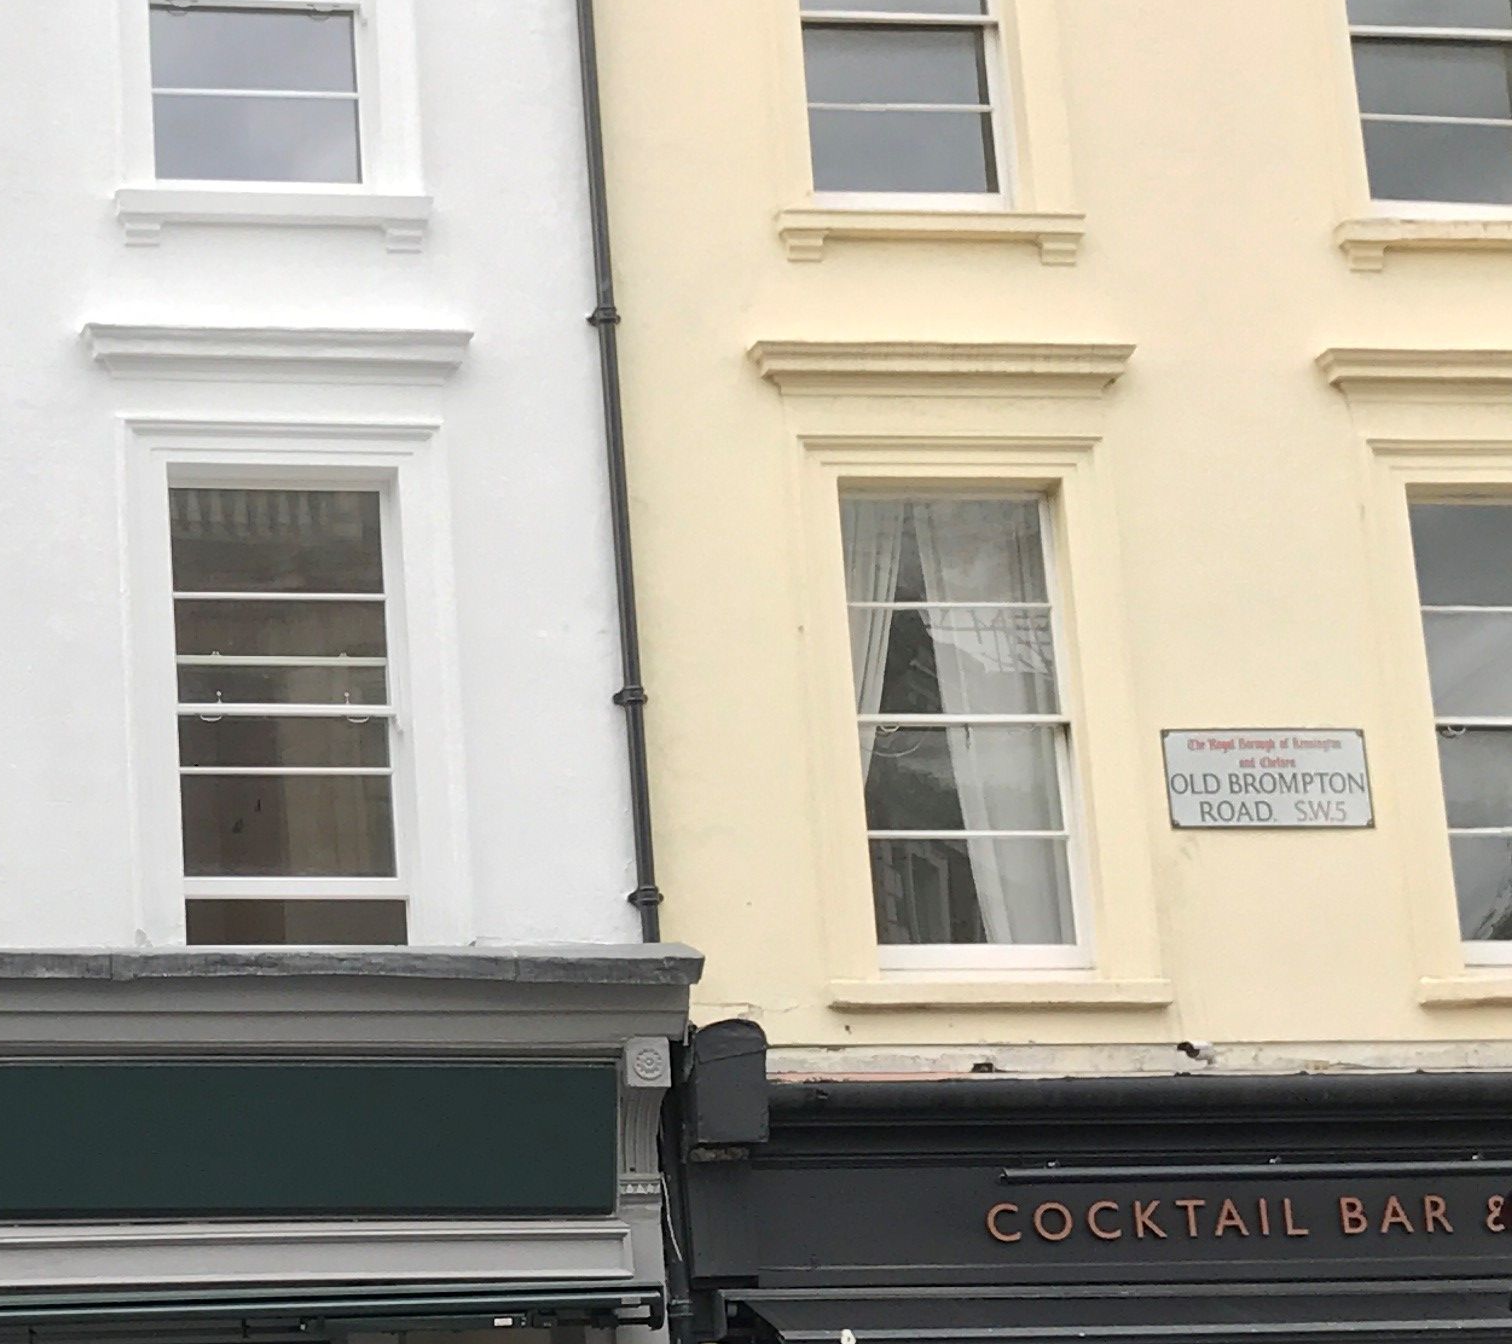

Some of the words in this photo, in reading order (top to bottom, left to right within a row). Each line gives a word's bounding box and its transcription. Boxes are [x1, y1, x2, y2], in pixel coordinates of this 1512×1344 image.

[1207, 738, 1235, 753] Royal
[1238, 738, 1275, 752] Borough
[1279, 738, 1289, 749] of
[1292, 737, 1342, 752] Kensington
[1239, 757, 1256, 768] and
[1259, 756, 1296, 768] Chelsea
[1170, 773, 1221, 794] OLD
[1228, 772, 1365, 794] BROMPTON
[987, 1197, 1309, 1242] COCKTAIL
[1339, 1195, 1453, 1234] BAR
